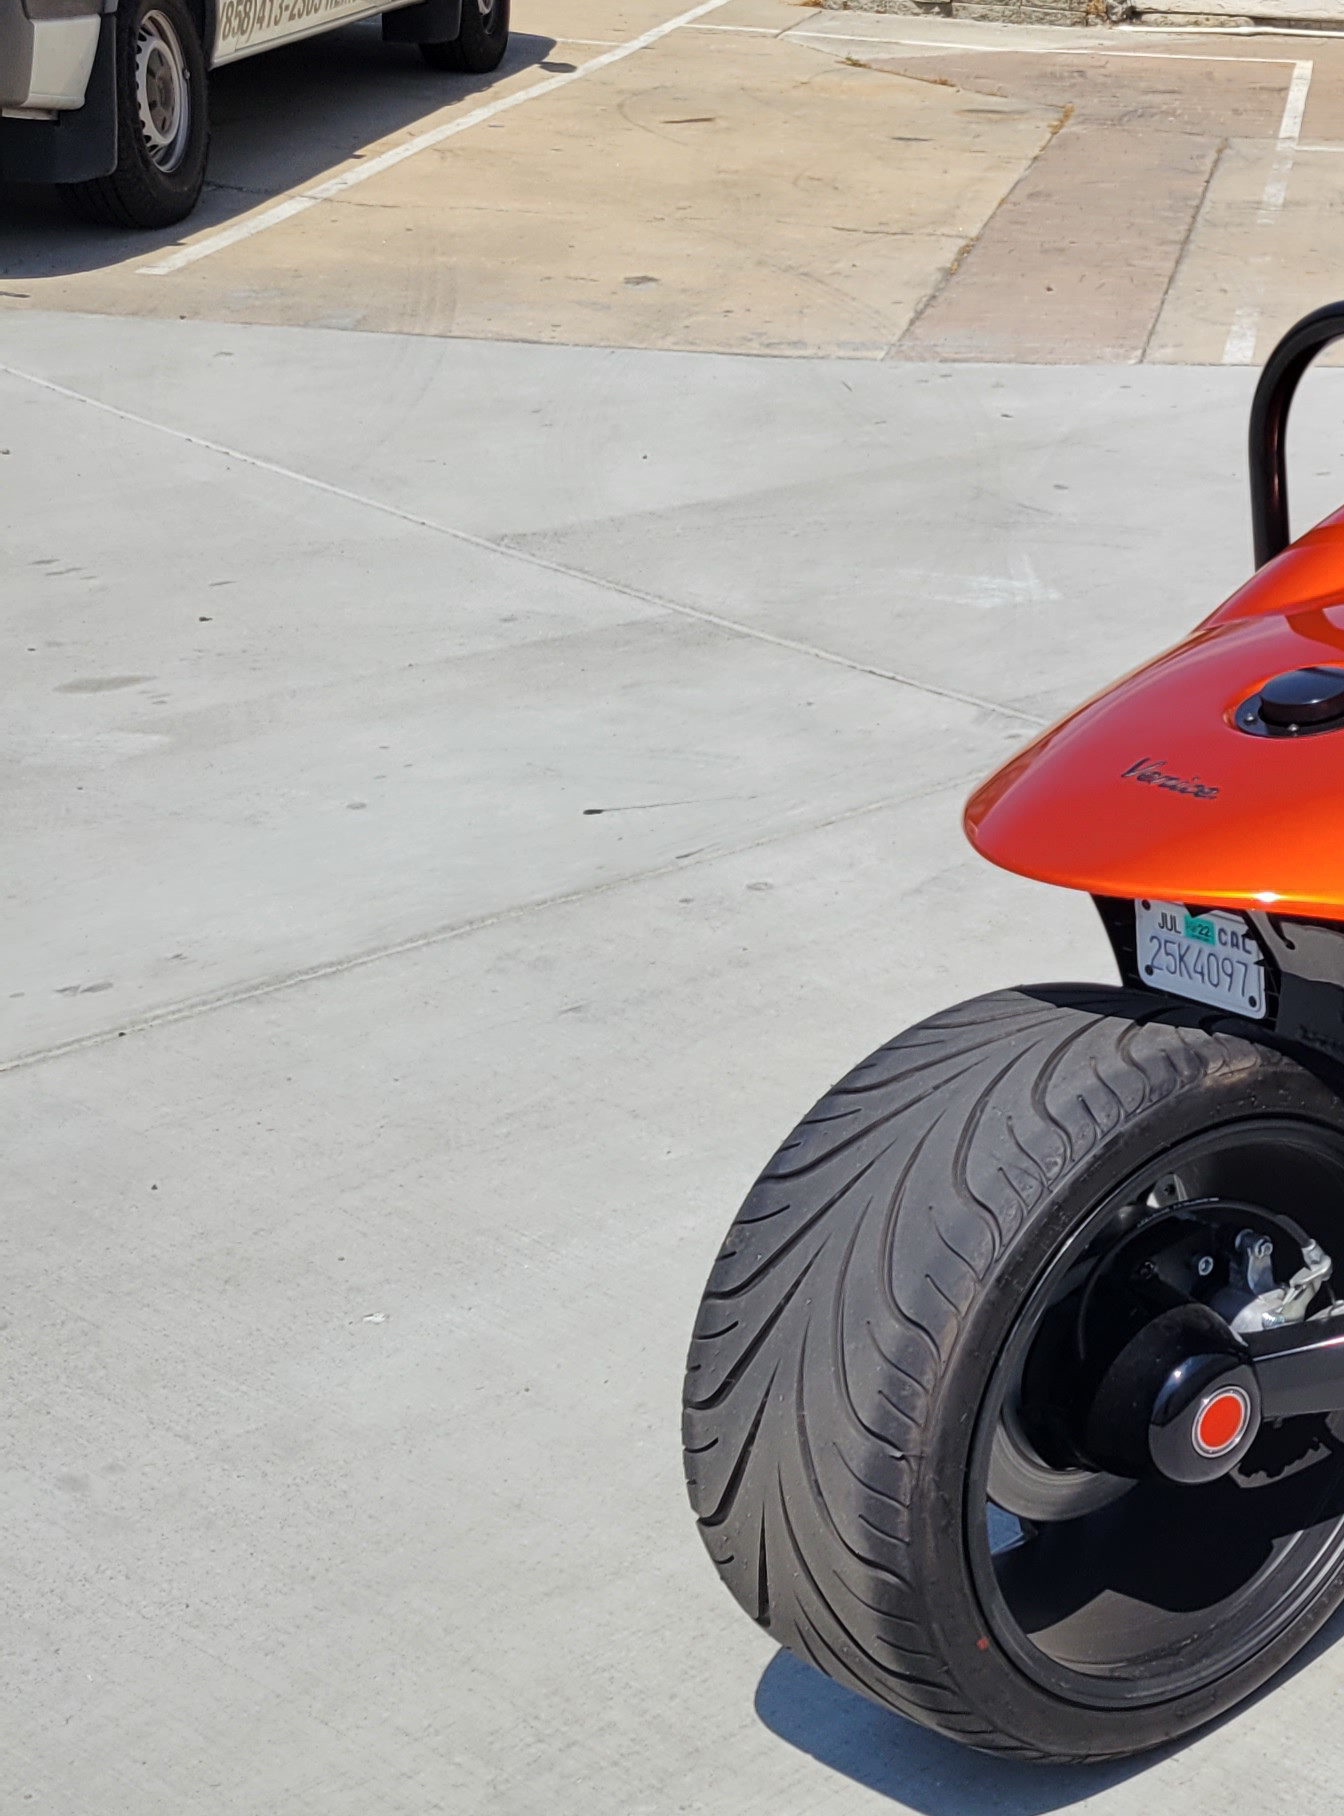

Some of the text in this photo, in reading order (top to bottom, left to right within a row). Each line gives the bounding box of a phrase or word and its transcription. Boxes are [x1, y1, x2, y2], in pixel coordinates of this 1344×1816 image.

[1158, 911, 1182, 934] JUL
[1218, 927, 1253, 955] CAL
[1149, 935, 1249, 998] 25K4097
